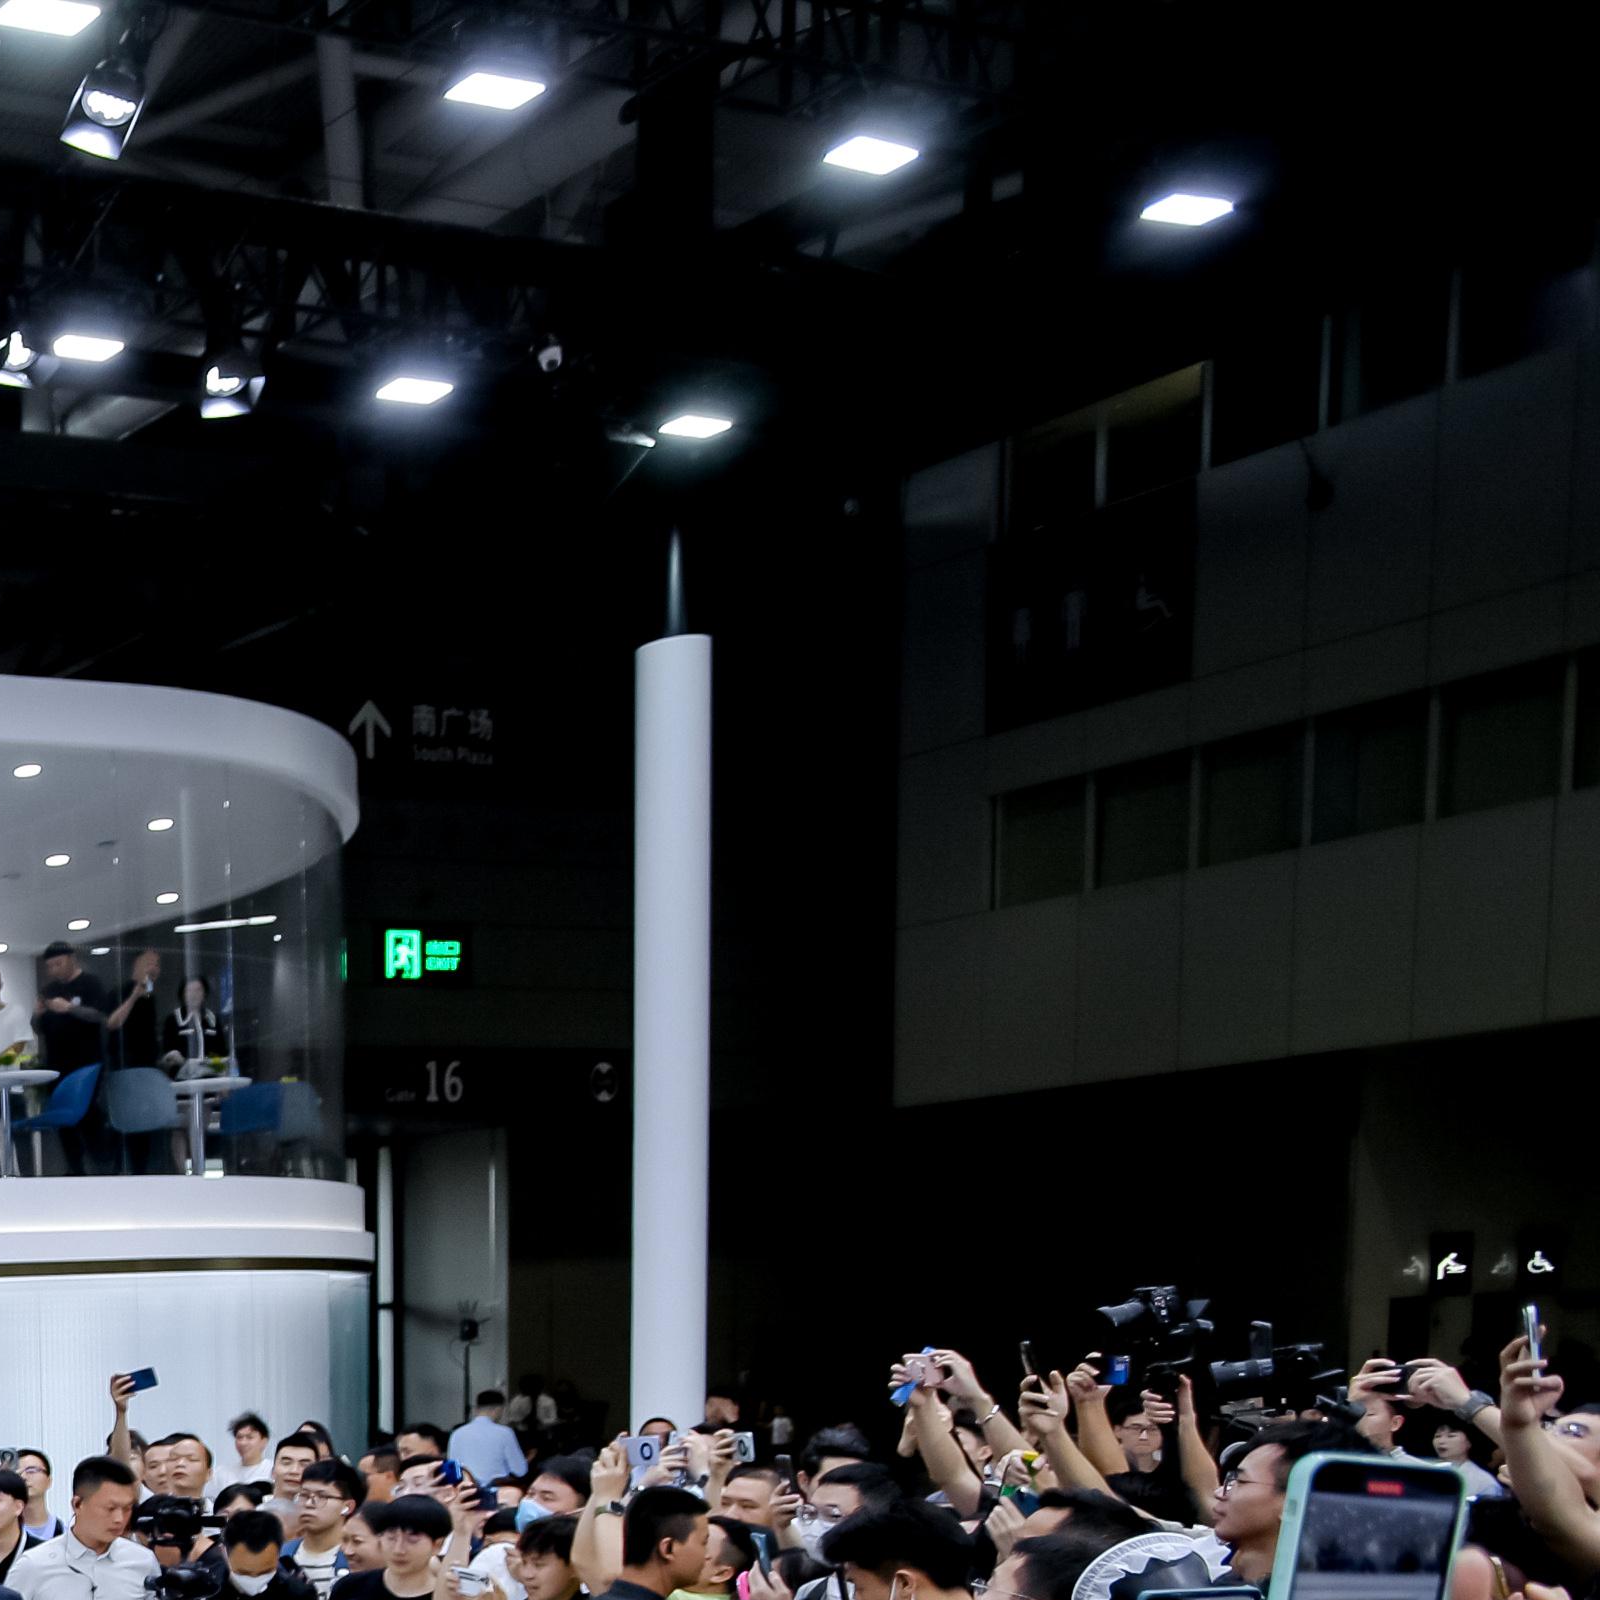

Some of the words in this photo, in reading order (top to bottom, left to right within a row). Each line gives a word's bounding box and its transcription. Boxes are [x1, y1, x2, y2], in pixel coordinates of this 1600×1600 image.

[412, 704, 494, 742] 南广场
[425, 1060, 464, 1103] 16
